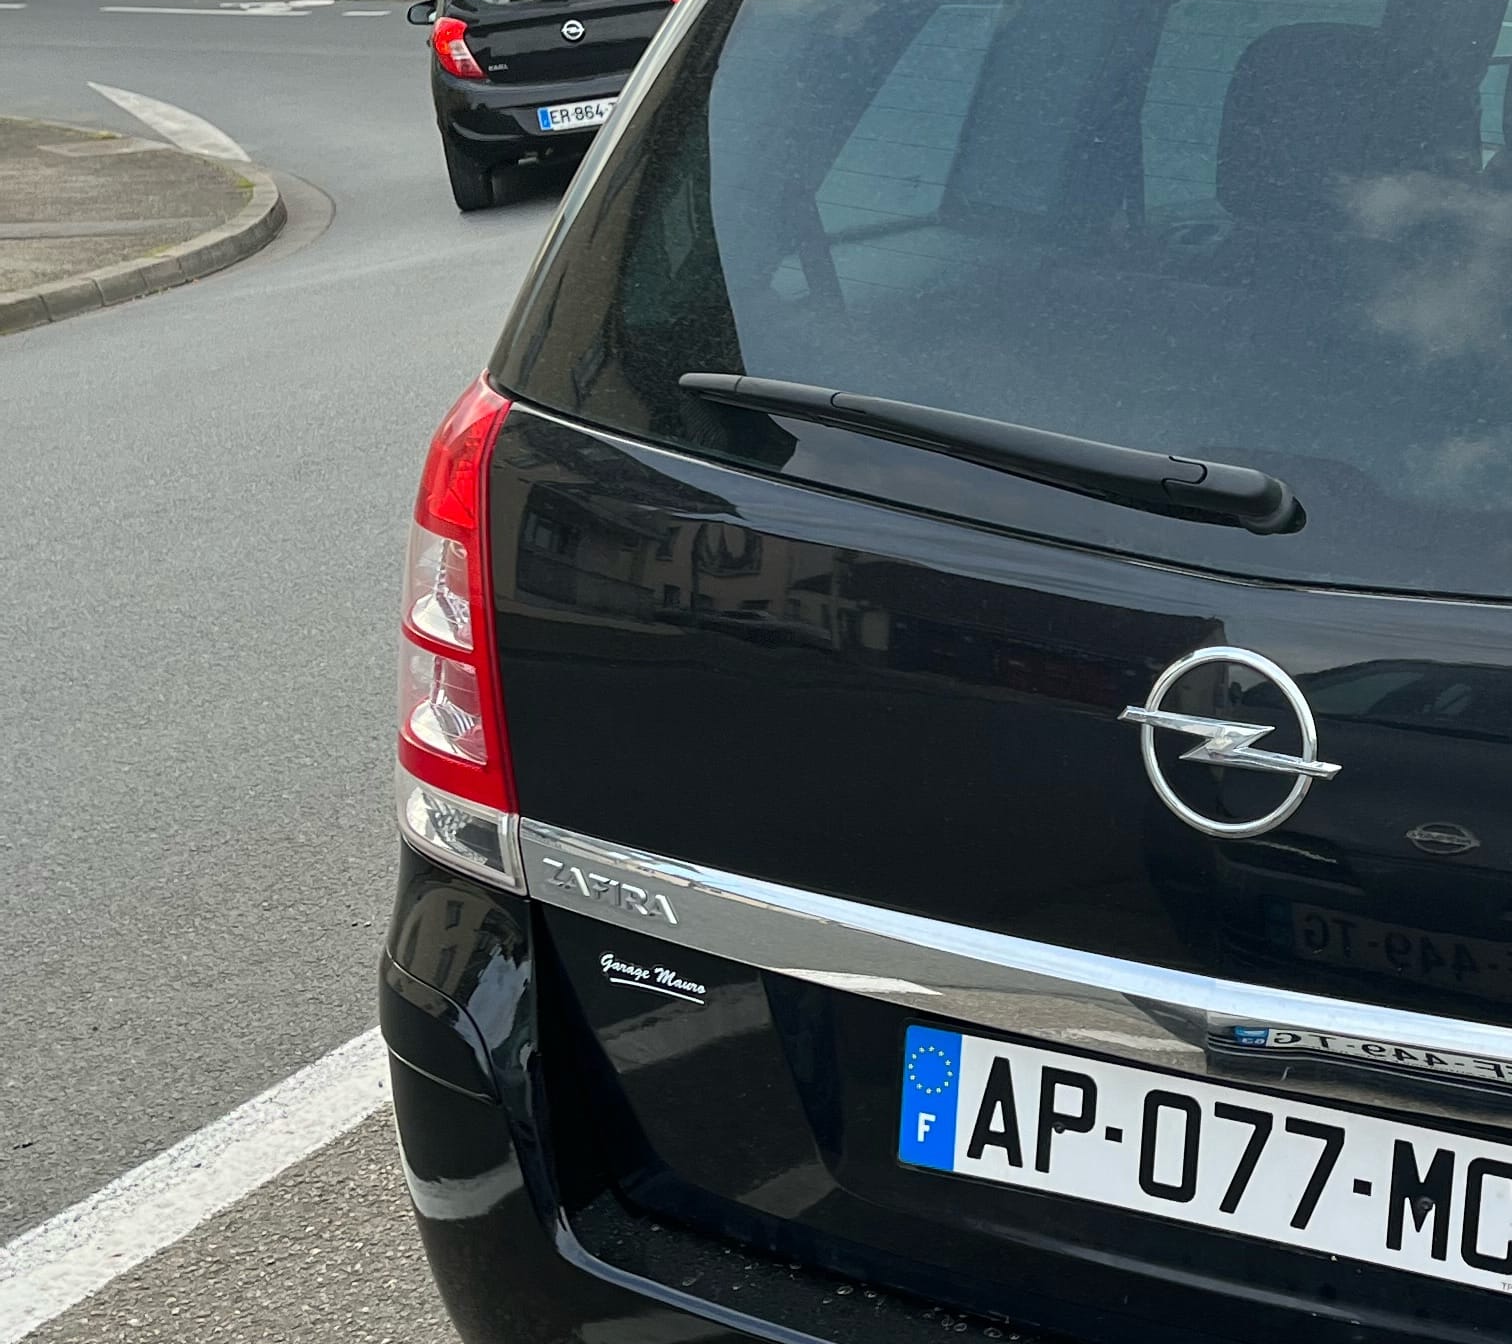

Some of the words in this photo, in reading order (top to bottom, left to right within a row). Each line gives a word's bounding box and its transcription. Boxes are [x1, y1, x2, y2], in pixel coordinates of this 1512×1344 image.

[543, 857, 678, 924] ZAFIRA
[601, 954, 650, 981] Garage
[654, 967, 706, 994] Mauro
[917, 1112, 937, 1143] F
